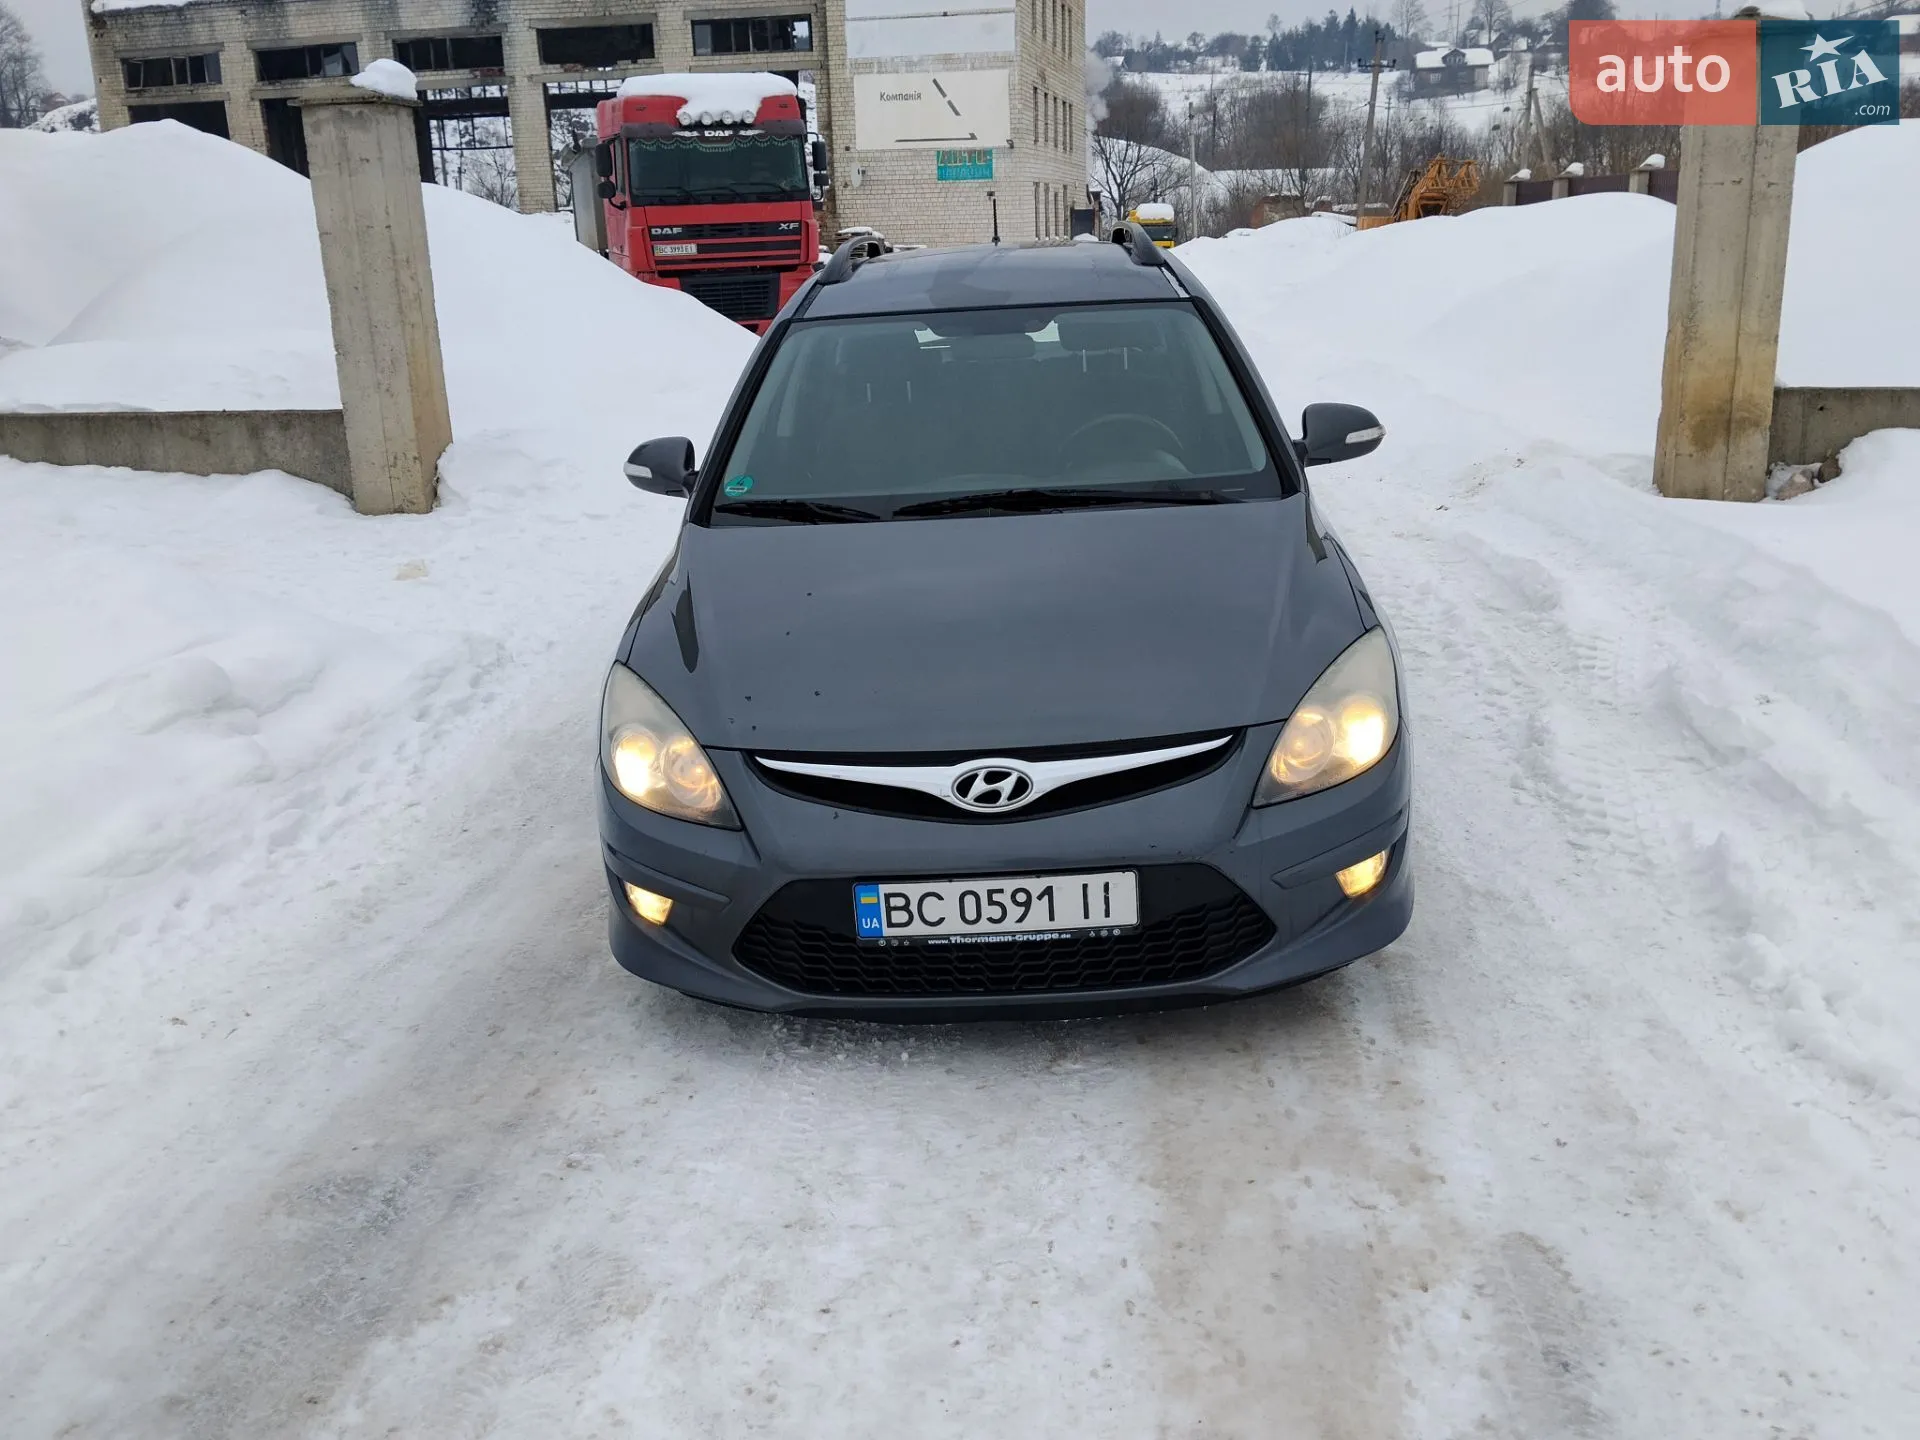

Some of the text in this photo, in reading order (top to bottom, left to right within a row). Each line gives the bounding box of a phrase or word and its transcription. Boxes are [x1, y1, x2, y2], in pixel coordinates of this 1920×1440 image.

[879, 90, 922, 102] Компанія
[704, 129, 734, 137] DAF
[651, 227, 683, 235] DAF
[778, 222, 799, 231] XF
[884, 890, 946, 929] BC
[958, 885, 1056, 926] 0591
[862, 917, 880, 930] UA
